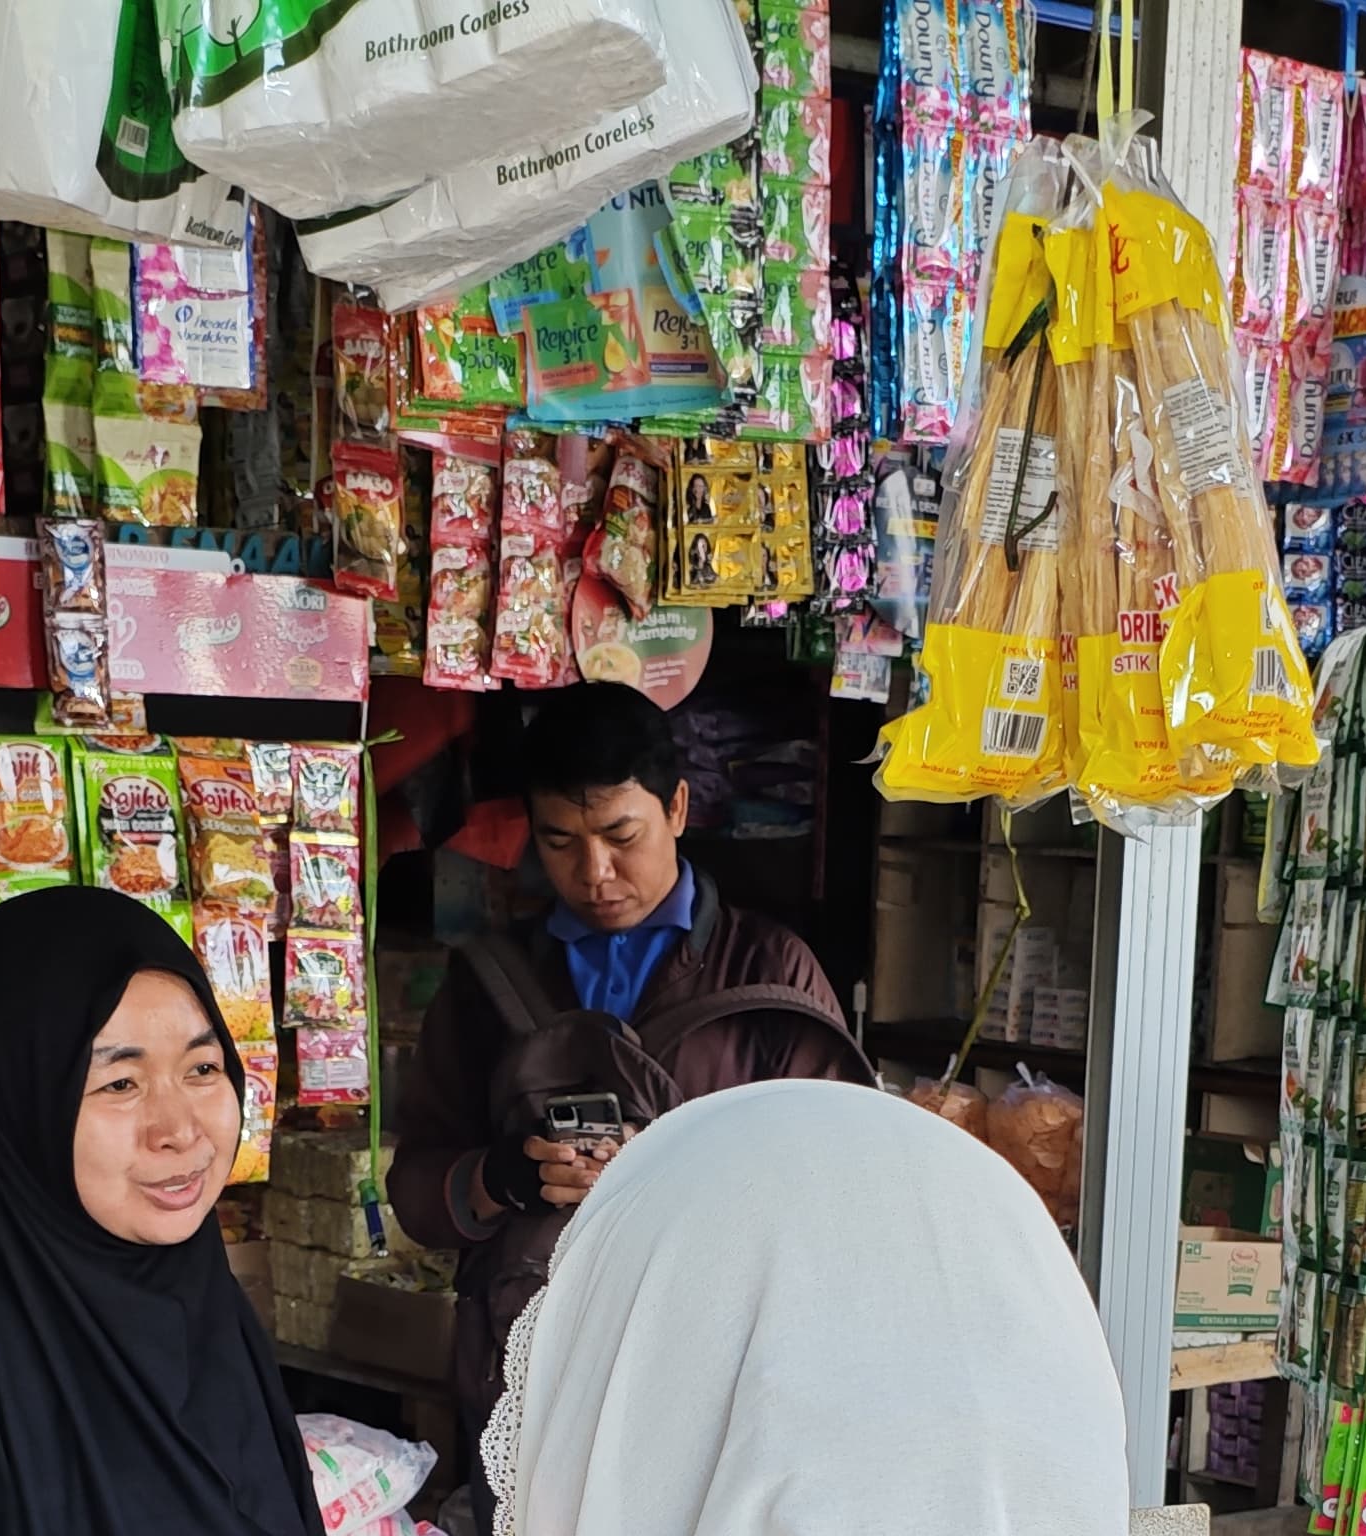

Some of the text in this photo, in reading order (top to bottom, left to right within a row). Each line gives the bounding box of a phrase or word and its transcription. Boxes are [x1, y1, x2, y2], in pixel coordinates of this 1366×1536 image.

[364, 0, 530, 62] Bathroom Coreless
[912, 0, 933, 88] Downy
[974, 11, 995, 98] Downy
[497, 112, 655, 186] Bathroom Coreless
[536, 323, 599, 352] Rejoice
[1301, 380, 1327, 459] Downy
[1114, 655, 1151, 673] STIK
[101, 780, 171, 816] Sajiku
[191, 780, 259, 815] Sajiku
